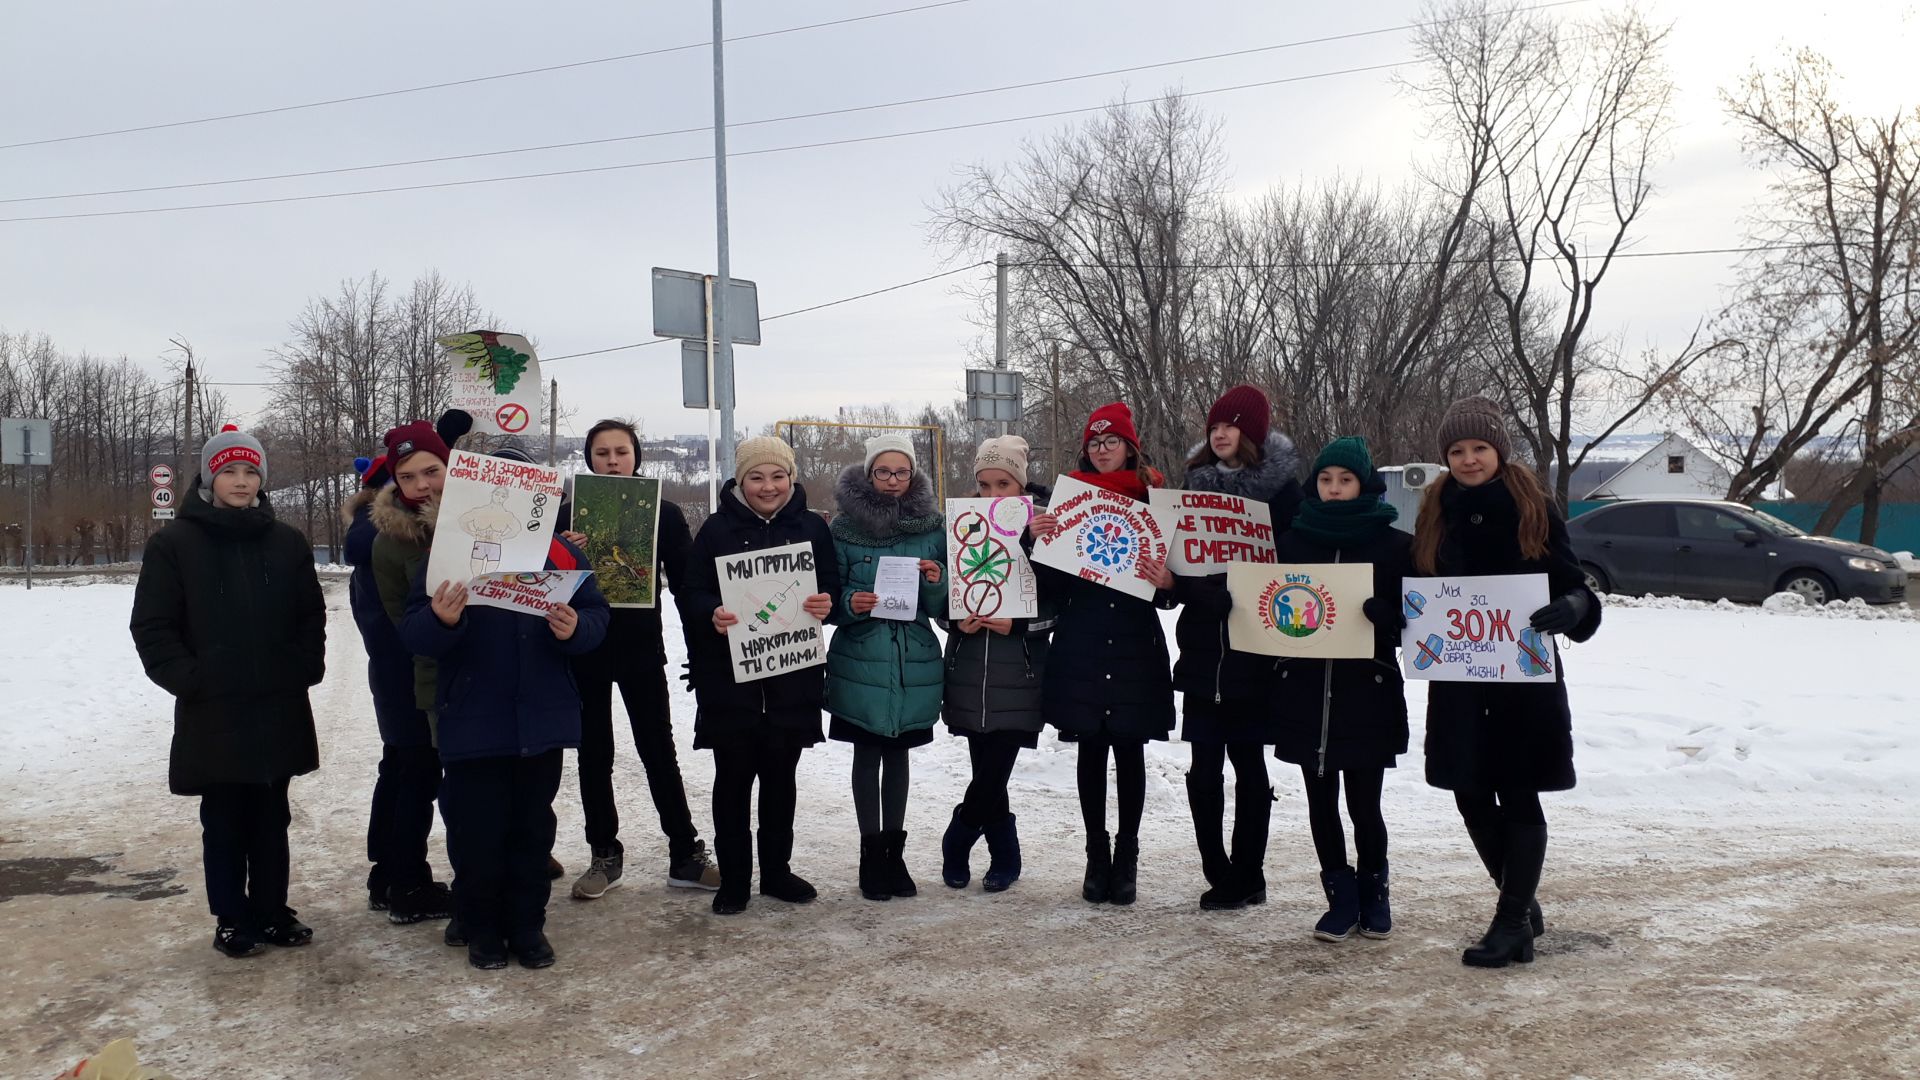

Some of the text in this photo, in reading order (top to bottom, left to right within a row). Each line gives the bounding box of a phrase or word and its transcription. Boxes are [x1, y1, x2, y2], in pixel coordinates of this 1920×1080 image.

[210, 449, 260, 470] Supreme
[456, 454, 558, 484] МЫ ЗА ЗДОРОВЫЙ
[450, 467, 479, 481] ОБРАЗ
[156, 492, 170, 502] 40
[1052, 490, 1093, 517] ОРОВОМУ
[1097, 489, 1134, 508] ОБРАЗУ
[1137, 507, 1163, 539] ЖИЗНИ
[1091, 504, 1145, 534] ПРИВЫЧКАМ
[1201, 516, 1272, 541] ТОРГУЮТ
[1184, 538, 1275, 564] СМЕРТЬЮ
[726, 551, 815, 581] МЫ ПРОТИВ
[486, 580, 548, 599] НАРКОТИКАМ
[1258, 579, 1281, 630] ЗДОРОВЫМ
[1284, 573, 1311, 584] БЫТЬ
[1446, 608, 1515, 642] ЗОЖ
[741, 626, 818, 659] НАРКОТИКОВ
[1445, 640, 1496, 653] ЗДОРОВЫЙ
[739, 646, 818, 674] ТЫ С НАМИ
[1443, 653, 1473, 664] ОБРАЗ
[1465, 664, 1505, 680] ЖИЗНИ!
